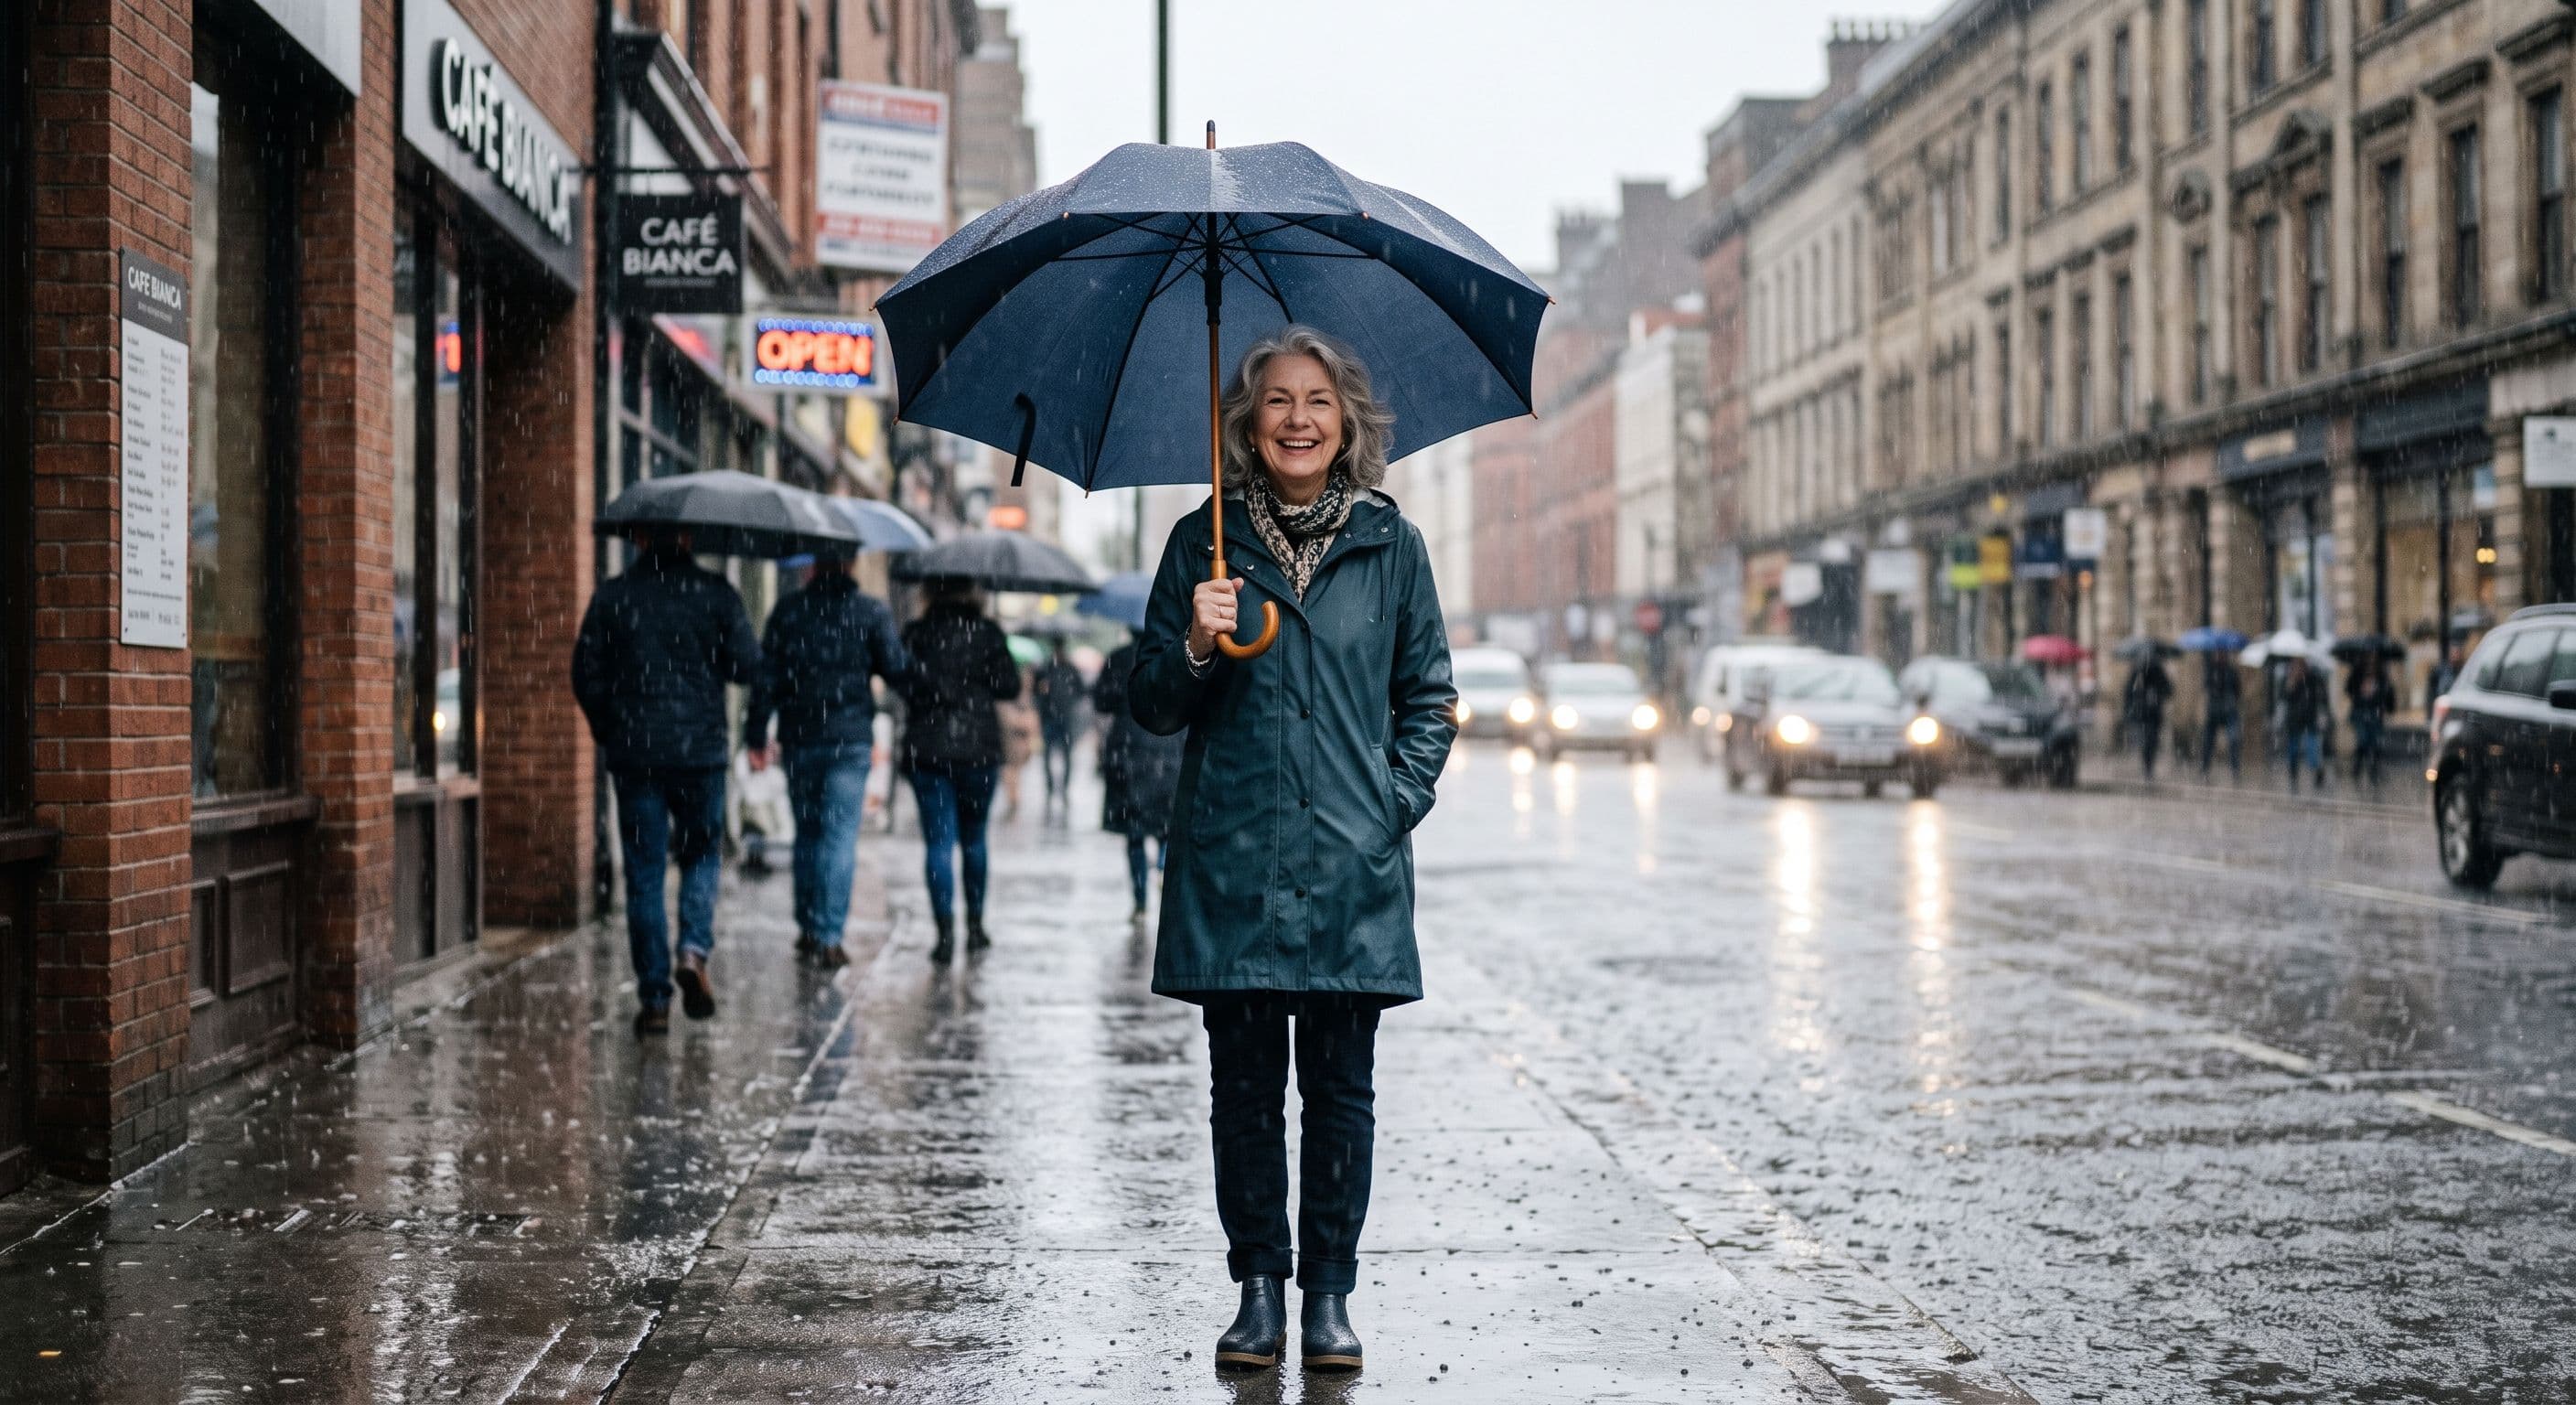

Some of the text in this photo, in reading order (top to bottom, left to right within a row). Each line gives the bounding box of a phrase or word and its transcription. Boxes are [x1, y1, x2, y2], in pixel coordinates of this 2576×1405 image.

[442, 37, 572, 245] CAFÉ BIANCA
[640, 212, 719, 246] CAFÉ
[622, 247, 737, 275] BIANCA
[151, 276, 182, 311] BIANCA
[757, 329, 874, 376] OPEN
